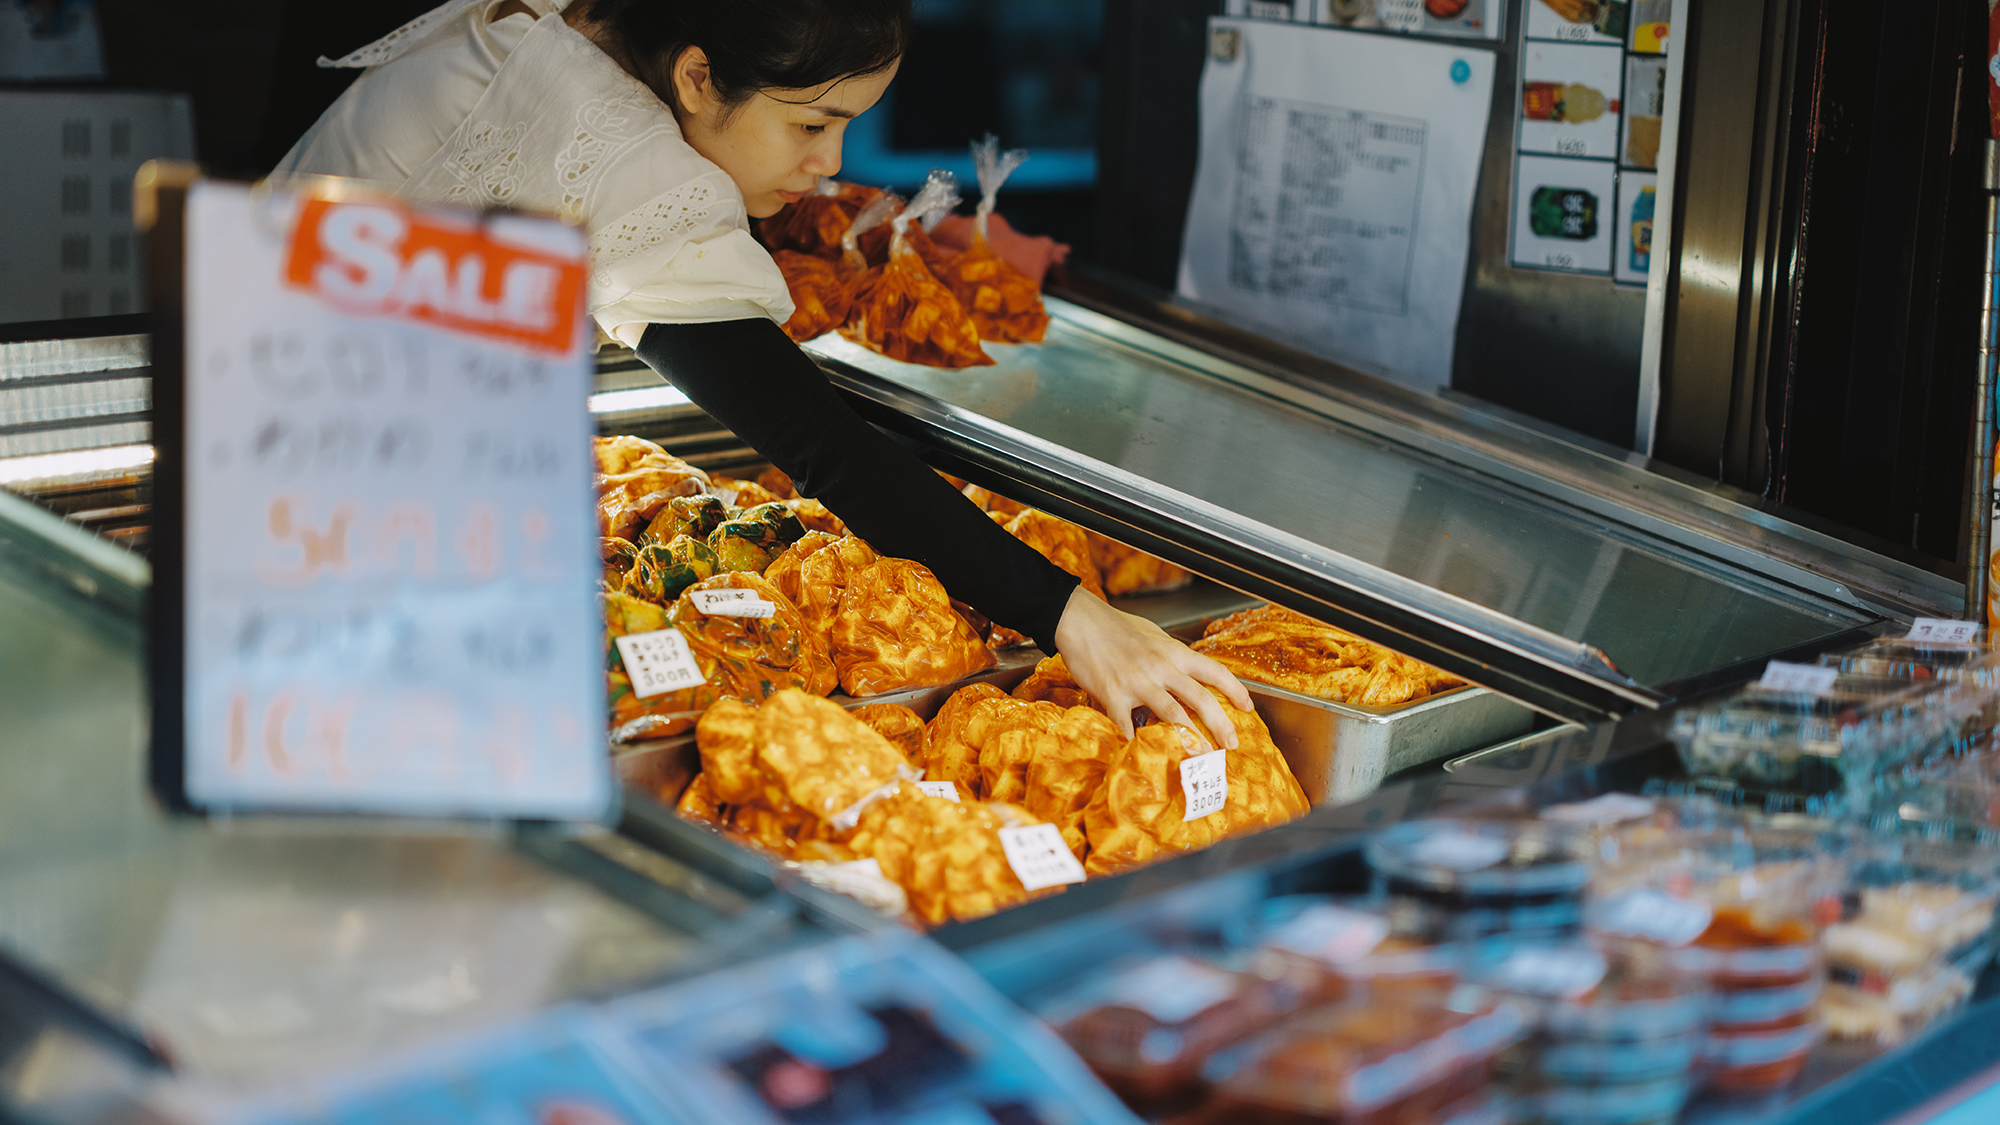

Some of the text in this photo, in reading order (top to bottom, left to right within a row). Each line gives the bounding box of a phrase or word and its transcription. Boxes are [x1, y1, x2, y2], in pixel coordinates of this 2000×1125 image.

[643, 668, 691, 687] 300円
[1202, 775, 1222, 790] キムチ
[1192, 791, 1222, 812] 300円
